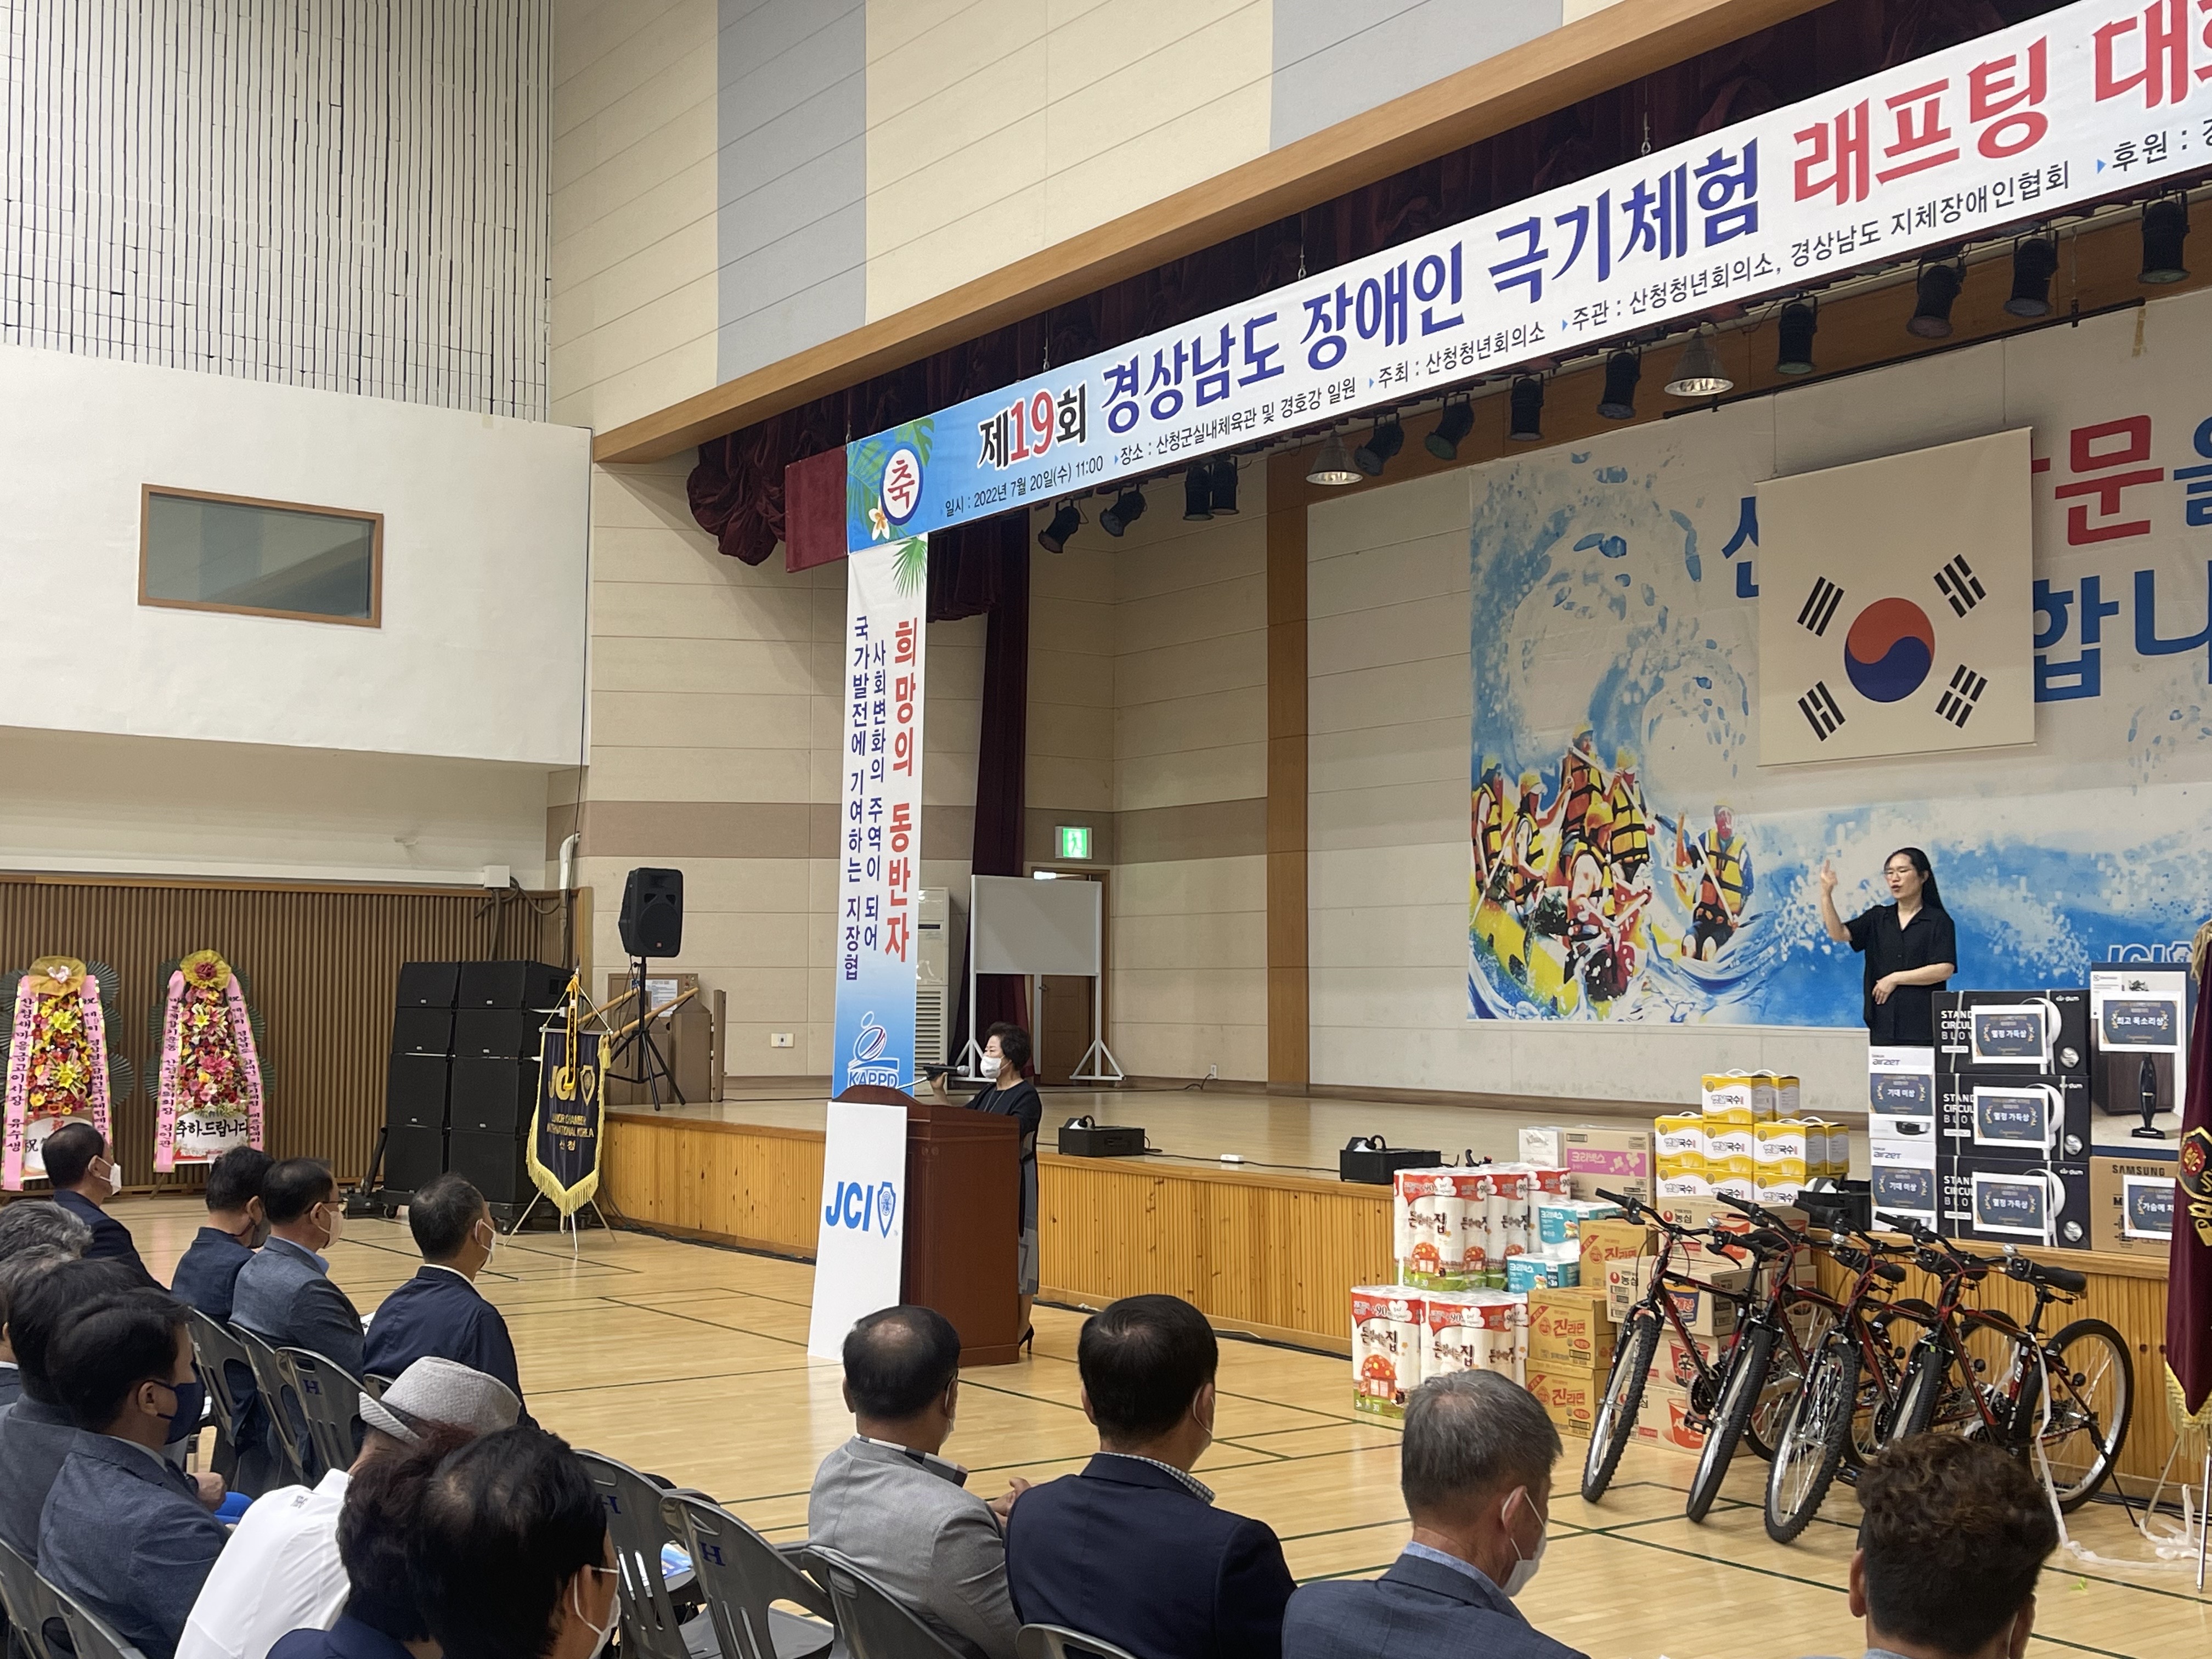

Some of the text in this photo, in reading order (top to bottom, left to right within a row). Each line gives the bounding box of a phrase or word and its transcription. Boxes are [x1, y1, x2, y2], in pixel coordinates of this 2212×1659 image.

[2112, 130, 2169, 172] 후원
[977, 383, 1087, 470] 제19회
[1102, 312, 1284, 433] 경상남도
[1300, 240, 1464, 370] 장애인
[1488, 137, 1758, 303] 극기체험
[1793, 35, 2049, 206] 래프팅
[1572, 303, 1610, 331] 주관
[1629, 253, 1781, 315] 산청청년회의소,
[1791, 219, 1882, 269] 경상남도
[1890, 161, 2070, 236] 지체장애인협회
[1378, 361, 1409, 389] 주최
[1426, 321, 1547, 374] 산청청년회의소
[945, 497, 964, 517] 일시
[974, 485, 1008, 509] 2022년
[1011, 477, 1026, 497] 7월
[1030, 465, 1072, 492] 20일(수)
[1076, 456, 1103, 478] 11:00
[1120, 445, 1144, 466] 장소
[1156, 407, 1258, 456] 산청군실내체육관
[1262, 402, 1274, 424] 및
[1280, 388, 1322, 419] 경호강
[1328, 376, 1356, 405] 일원
[887, 459, 916, 511] 축
[845, 616, 870, 980] 국가발전에 기여하는 지장협
[864, 640, 886, 951] 사회변화의 주역이 되어
[885, 617, 918, 962] 희망의 동반자
[1941, 1010, 1972, 1019] STAND
[1943, 1094, 1974, 1103] STAND
[2112, 1164, 2165, 1176] SAMSUNG
[825, 1181, 874, 1232] JCI
[1674, 1214, 1692, 1224] 농심
[1553, 1318, 1585, 1338] 진라면
[303, 1379, 323, 1396] H
[1552, 1388, 1585, 1408] 진라면
[698, 1542, 726, 1567] H
